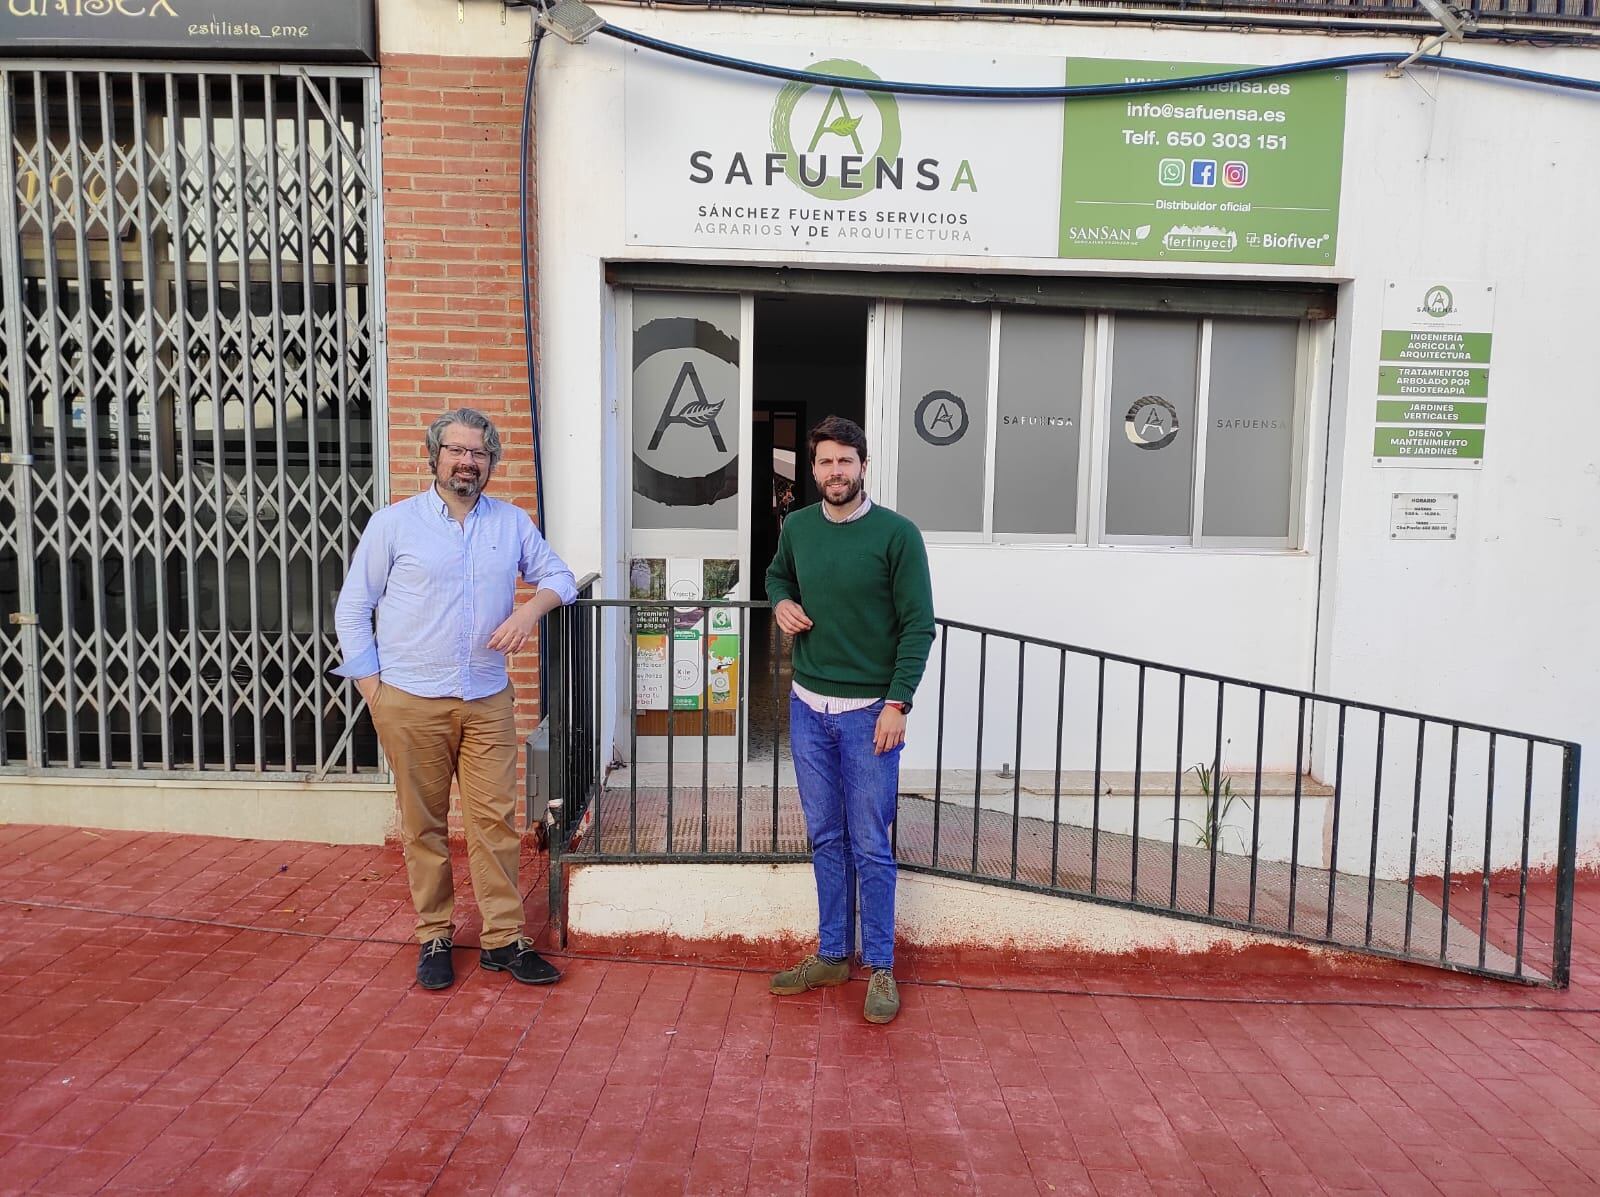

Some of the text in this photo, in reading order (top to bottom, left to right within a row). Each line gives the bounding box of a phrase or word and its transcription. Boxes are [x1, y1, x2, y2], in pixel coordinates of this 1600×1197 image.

[1127, 102, 1286, 122] info@safuensa.es
[1122, 130, 1288, 150] Telf. 650 303 151
[688, 150, 978, 193] SAFUENSA
[1156, 199, 1252, 213] Distribuidor oficial
[698, 203, 969, 225] SÁNCHEZ FUENTES SERVICIOS
[694, 222, 973, 242] AGRARIOS Y DE ARQUITECTURA
[1458, 343, 1465, 351] Y
[1399, 350, 1472, 360] ARQUITECTURA
[1398, 368, 1470, 377] TRATAMIENTOS
[1396, 377, 1471, 386] ARBOLADO POR
[1400, 386, 1466, 395] ENDOTERAPIA
[1409, 404, 1454, 412] JARDINES
[1003, 415, 1073, 426] SAFUENSA
[1403, 412, 1459, 421] VERTICALES
[1445, 430, 1453, 438] Y
[1390, 438, 1468, 448] MANTENIMIENTO
[1413, 447, 1458, 455] JARDINES
